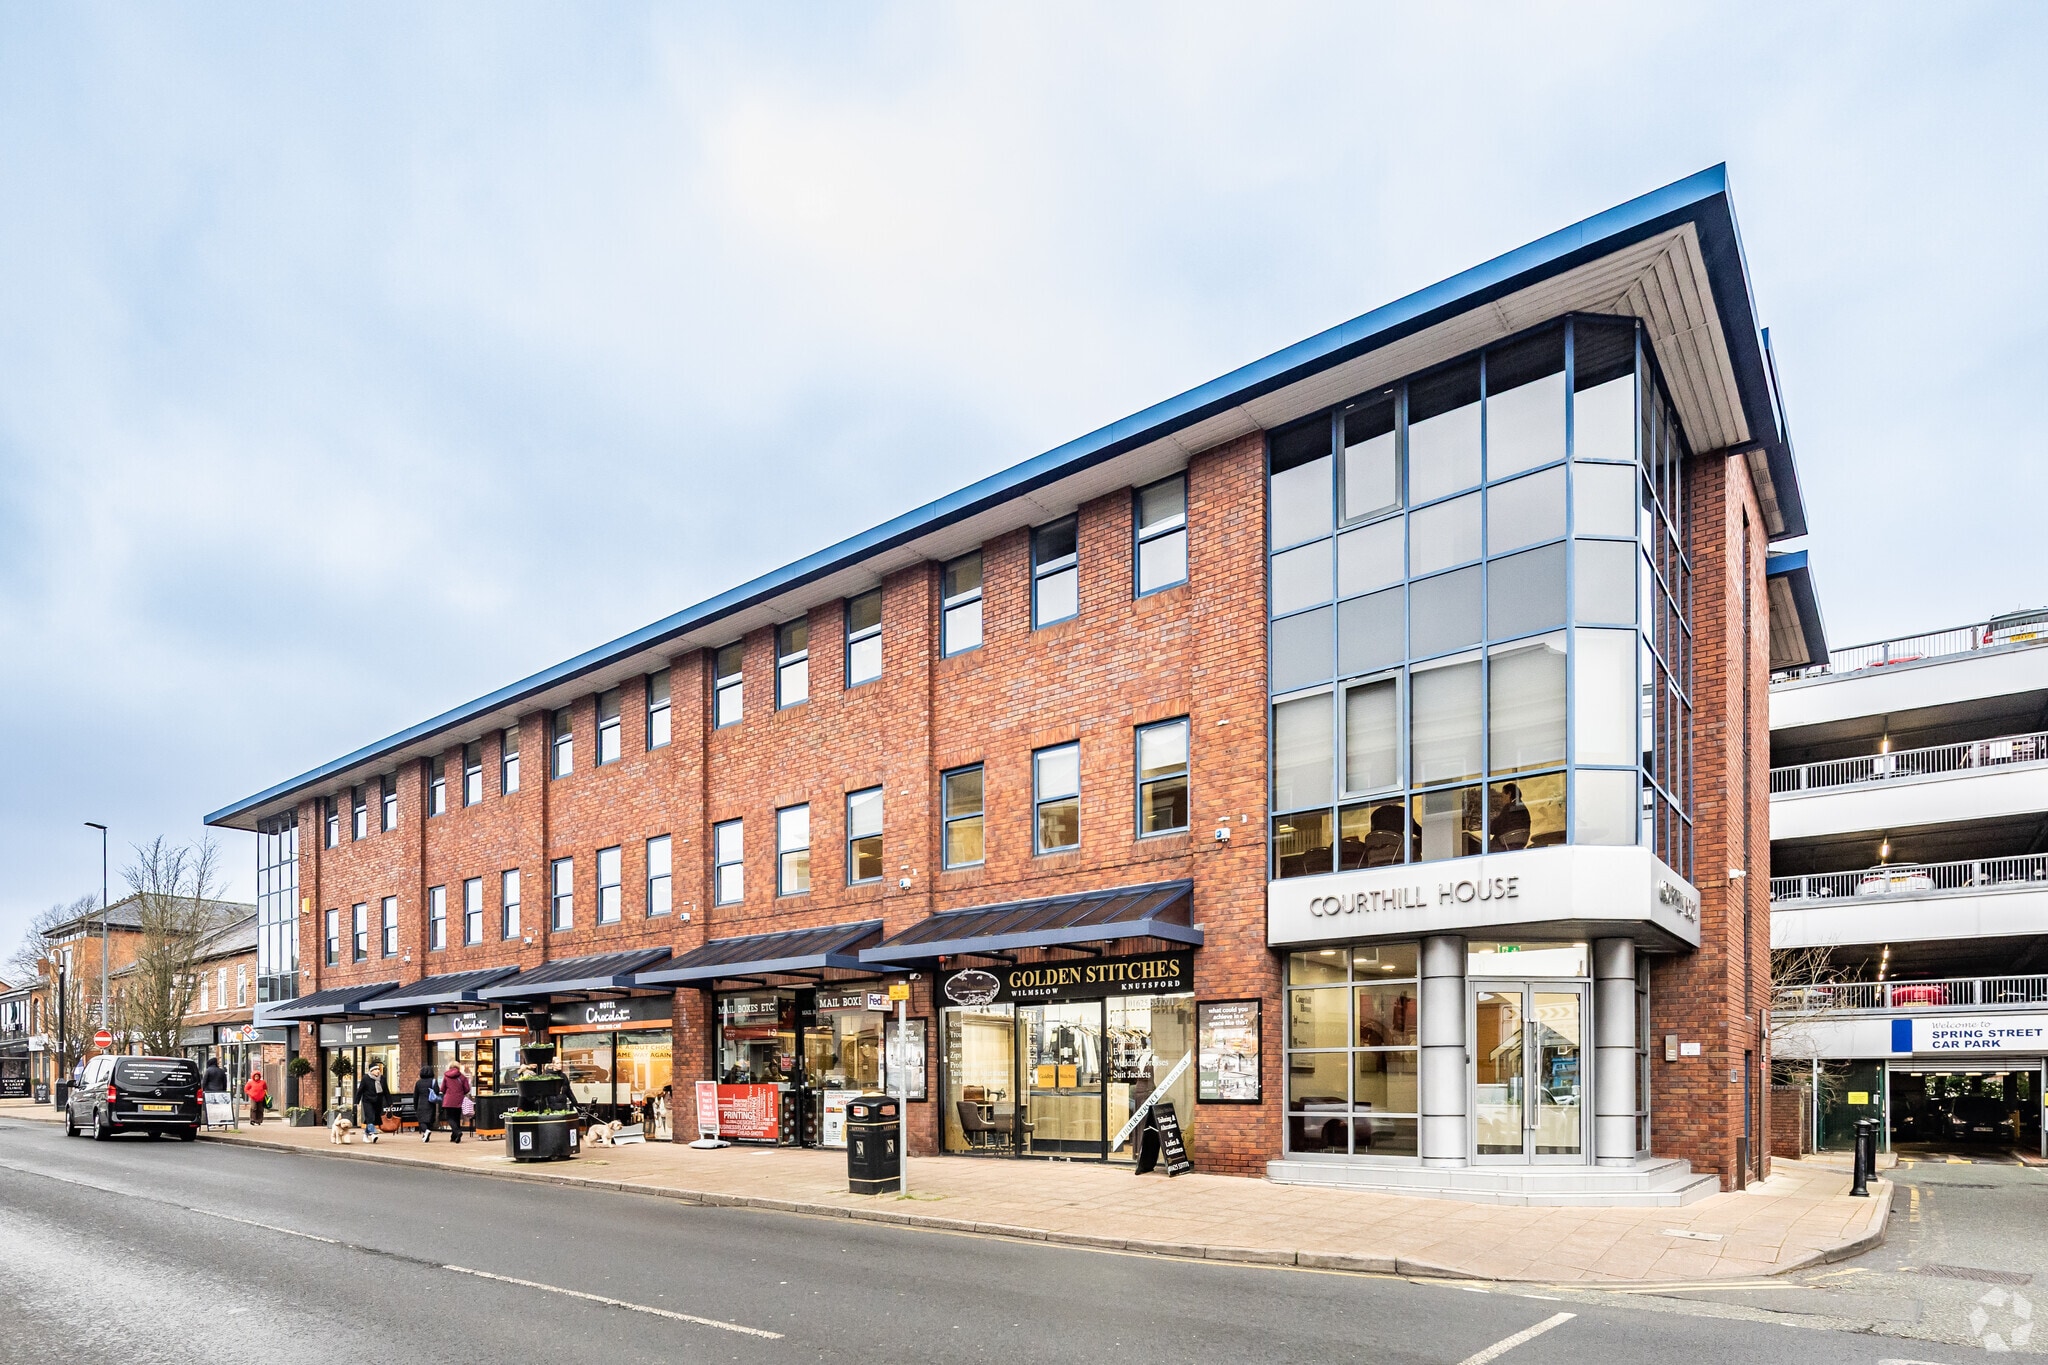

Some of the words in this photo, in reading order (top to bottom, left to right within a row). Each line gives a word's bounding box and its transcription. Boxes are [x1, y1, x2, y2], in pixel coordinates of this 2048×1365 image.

[1309, 886, 1427, 917] COURTHILL
[1438, 876, 1519, 904] HOUSE
[1009, 966, 1081, 988] GOLDEN
[1086, 959, 1180, 983] STITCHES
[1121, 980, 1181, 990] KNUTSFORD
[1011, 988, 1059, 997] WILMSLOW
[819, 998, 840, 1008] MAIL
[842, 996, 862, 1007] BOXE
[718, 1005, 735, 1015] MAIL
[738, 1004, 759, 1013] BOXES
[1931, 1021, 1978, 1029] Welcome
[1980, 1020, 1992, 1028] to
[1932, 1030, 1983, 1039] SPRING
[1988, 1028, 2043, 1037] STREET
[1932, 1040, 1960, 1049] CAR
[1964, 1039, 2001, 1048] PARK
[1112, 1070, 1126, 1079] Suit
[1127, 1070, 1152, 1079] Jackets
[1137, 1092, 1160, 1119] SERVICE
[724, 1111, 753, 1119] PRINTING
